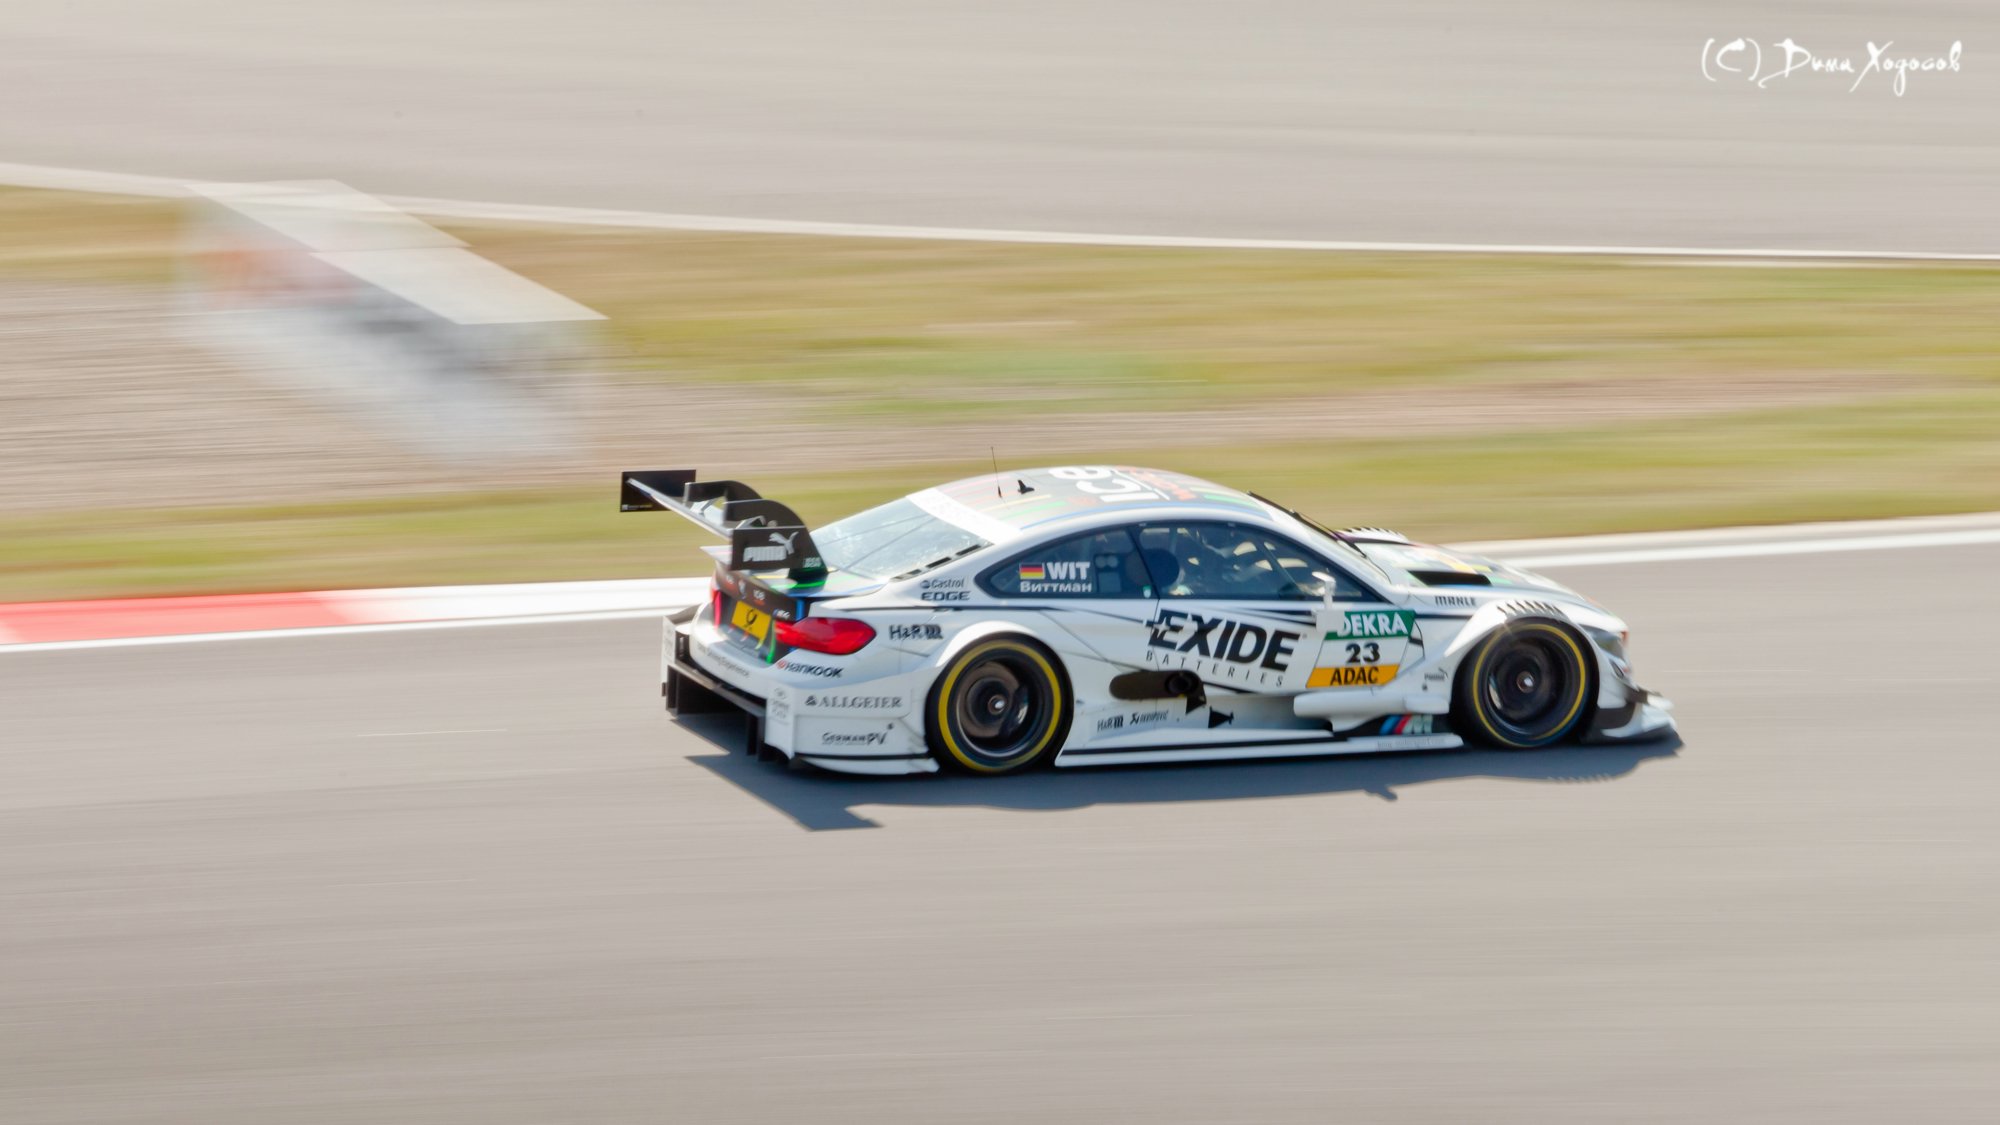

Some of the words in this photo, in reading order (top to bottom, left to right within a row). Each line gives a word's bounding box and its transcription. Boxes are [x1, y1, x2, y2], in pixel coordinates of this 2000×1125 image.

[1046, 561, 1091, 580] WIT
[931, 578, 965, 589] Castrol
[1020, 580, 1092, 593] Виттман
[921, 591, 971, 601] EDGE
[1336, 612, 1408, 637] DEKRA
[1147, 608, 1300, 672] EXIDE
[1345, 642, 1380, 664] 23
[1146, 650, 1285, 688] BATTERIES
[1329, 666, 1379, 686] ADAC
[818, 695, 902, 709] ALLGEIER
